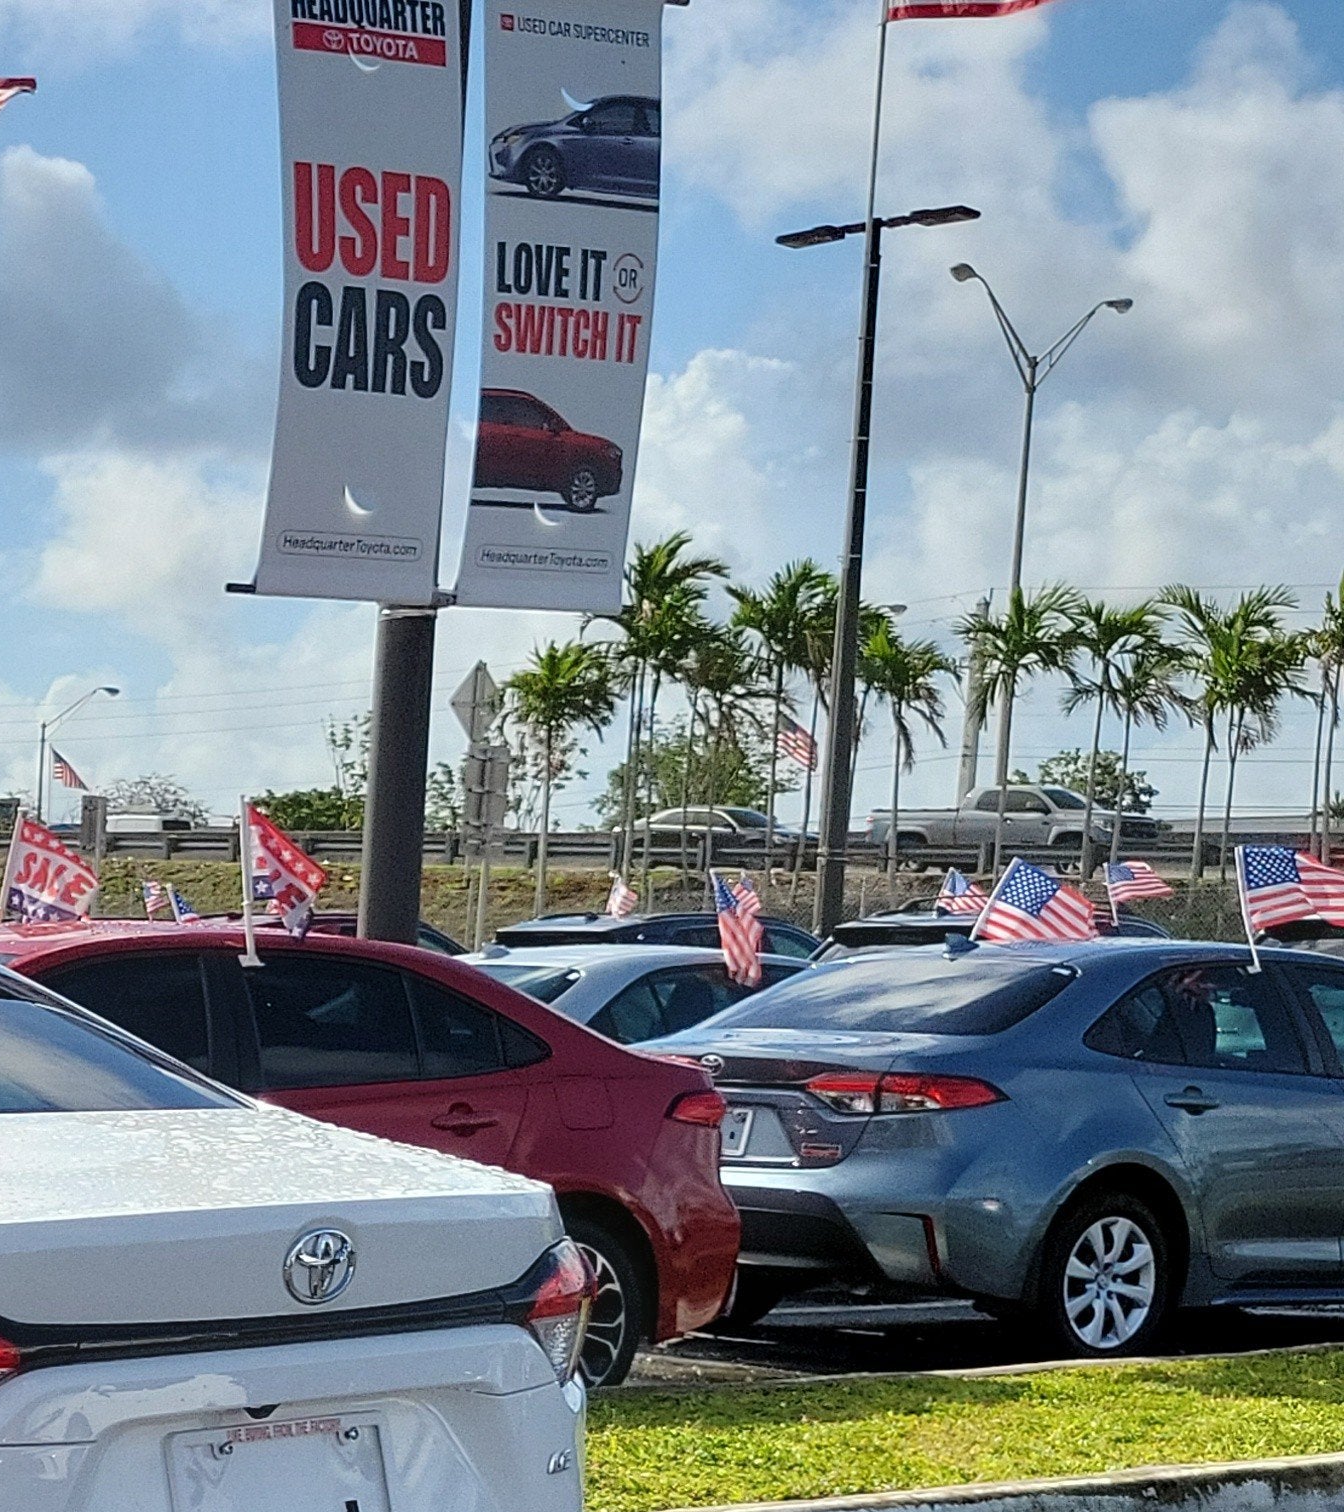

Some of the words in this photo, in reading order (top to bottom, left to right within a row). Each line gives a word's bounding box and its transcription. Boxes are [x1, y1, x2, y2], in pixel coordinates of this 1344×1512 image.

[291, 0, 446, 37] HEADQUARTER
[517, 17, 546, 35] USED
[549, 21, 571, 38] CAR
[573, 24, 650, 48] SUPERCENTER
[348, 32, 419, 60] TOYOTA
[294, 161, 450, 284] USED
[496, 241, 571, 298] LOVE
[579, 248, 607, 302] IT
[618, 267, 638, 289] OR
[293, 281, 447, 399] CARS
[493, 302, 609, 361] SWITCH
[615, 313, 642, 364] IT
[283, 535, 417, 557] HeadquarterToyota.com
[481, 549, 608, 569] HeadquarterToyota.com
[14, 851, 94, 906] SALE
